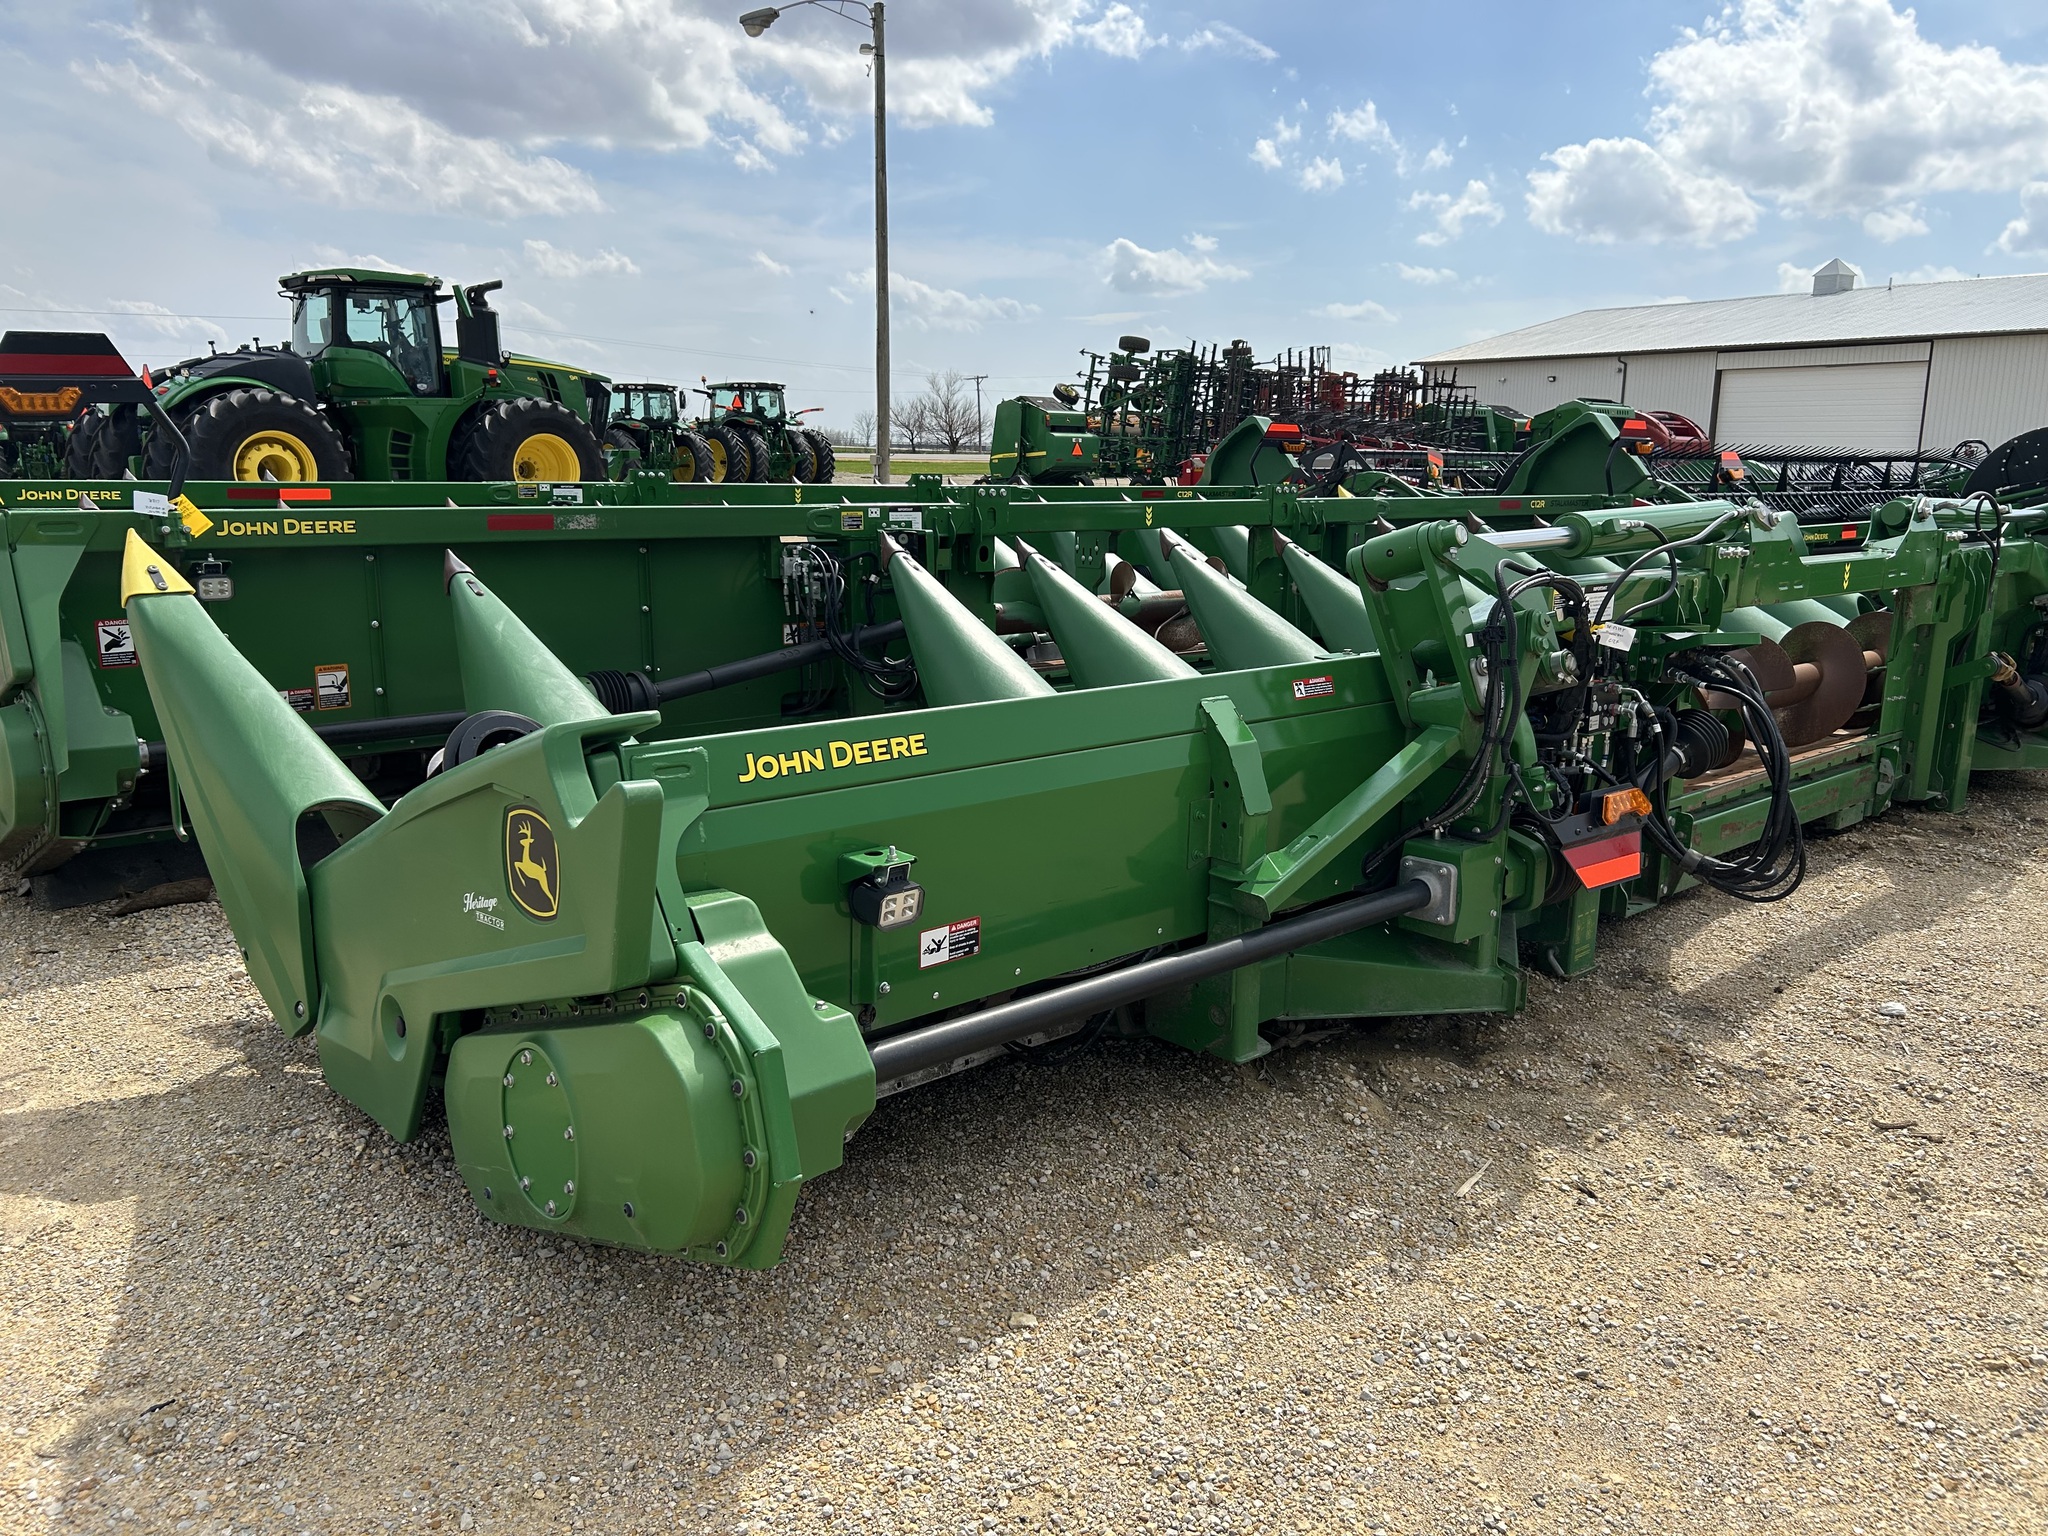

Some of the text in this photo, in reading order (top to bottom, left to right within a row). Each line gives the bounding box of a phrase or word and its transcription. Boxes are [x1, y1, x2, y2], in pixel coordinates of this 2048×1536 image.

[16, 488, 62, 501] JOHN
[1530, 500, 1546, 508] C12R
[216, 519, 279, 537] JOHN
[282, 518, 357, 535] DEERE
[1804, 533, 1815, 541] OHN
[738, 733, 928, 783] JOHN DEERE
[463, 892, 498, 913] Heritage
[475, 911, 505, 929] TRACTOR
[956, 919, 977, 930] DANGER
